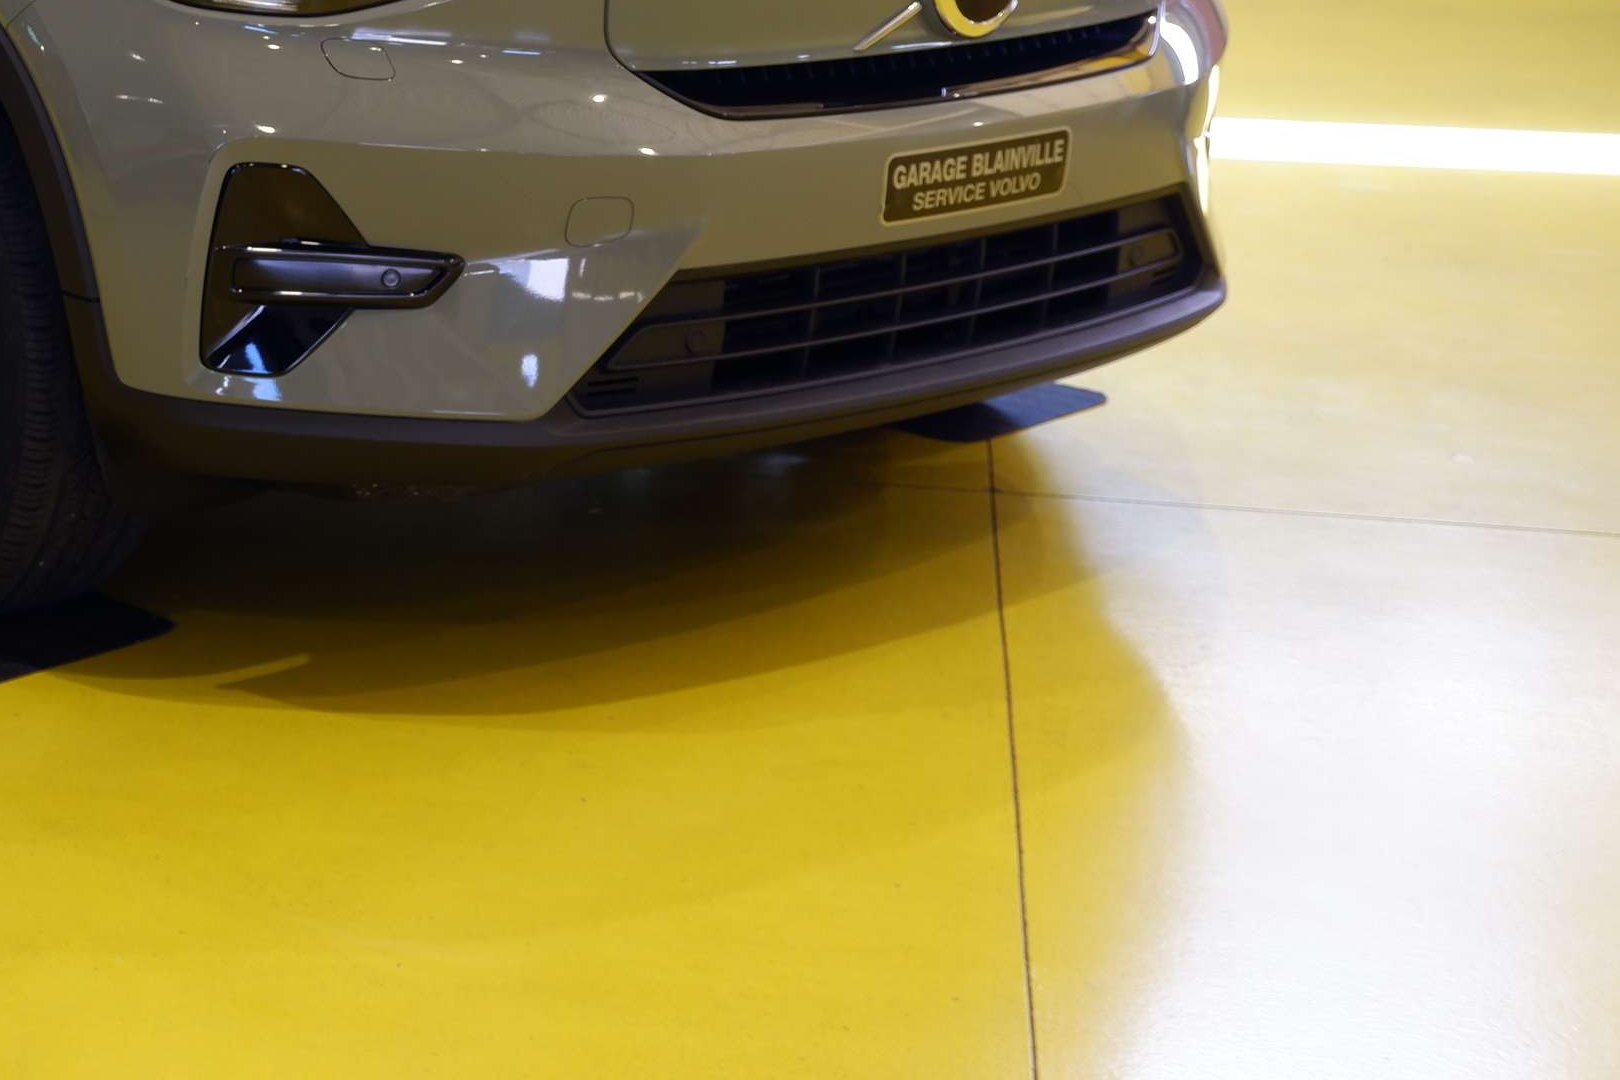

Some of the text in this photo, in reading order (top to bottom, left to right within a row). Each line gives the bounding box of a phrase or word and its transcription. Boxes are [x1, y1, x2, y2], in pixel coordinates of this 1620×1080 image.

[893, 139, 1065, 189] GARAGE BLAINVILLE
[912, 173, 1041, 211] SERVICE VOLVO
